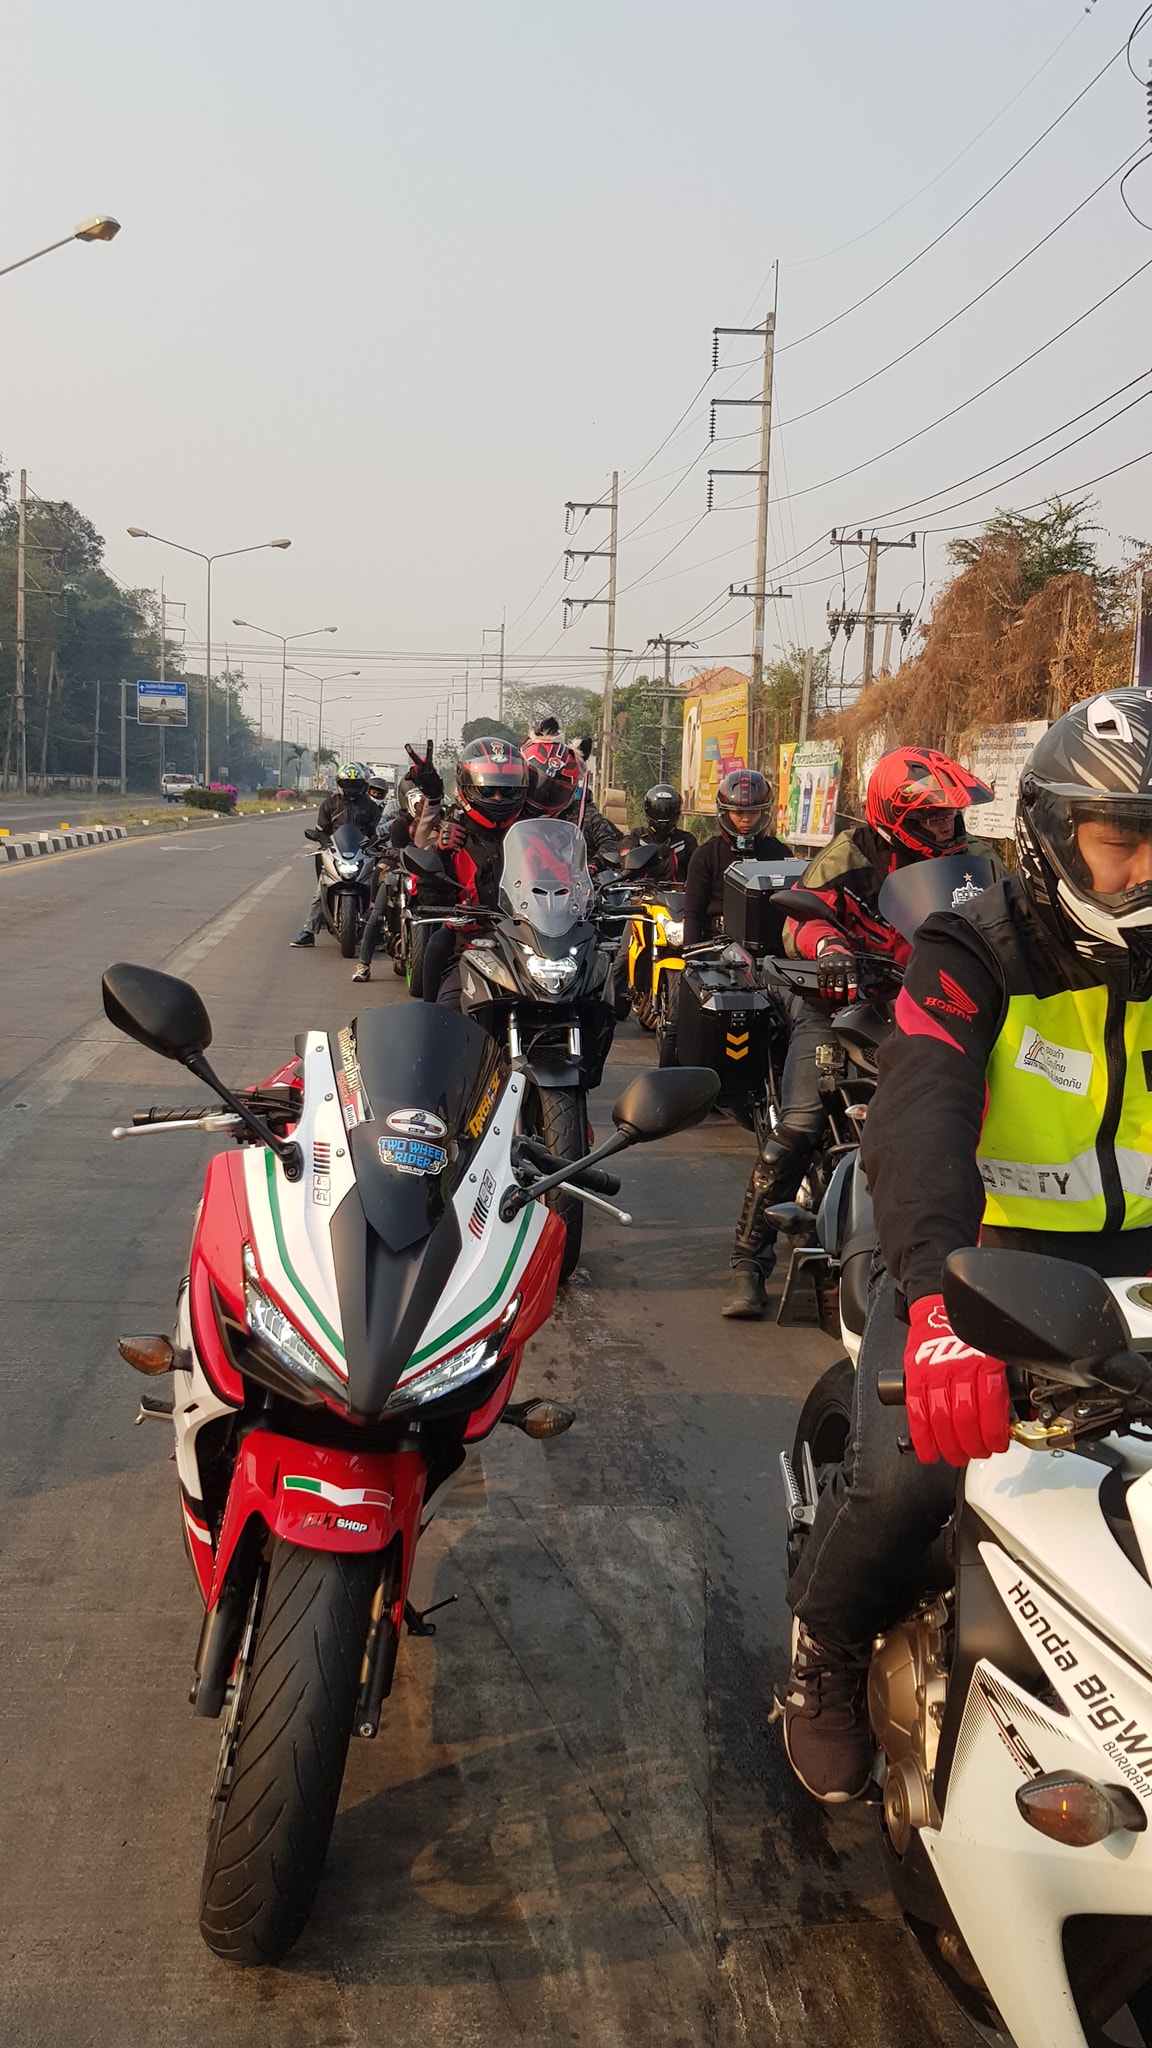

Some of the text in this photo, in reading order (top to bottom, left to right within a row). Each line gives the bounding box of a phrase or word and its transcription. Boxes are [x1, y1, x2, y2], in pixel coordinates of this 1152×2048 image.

[381, 1139, 445, 1163] TWO WHEEL
[394, 1152, 432, 1169] RIDER
[313, 1174, 331, 1206] 93
[981, 1163, 1071, 1195] AFETY
[336, 1518, 368, 1533] SHOP
[1008, 1580, 1079, 1672] Honda
[1102, 1741, 1152, 1798] BURIRAM
